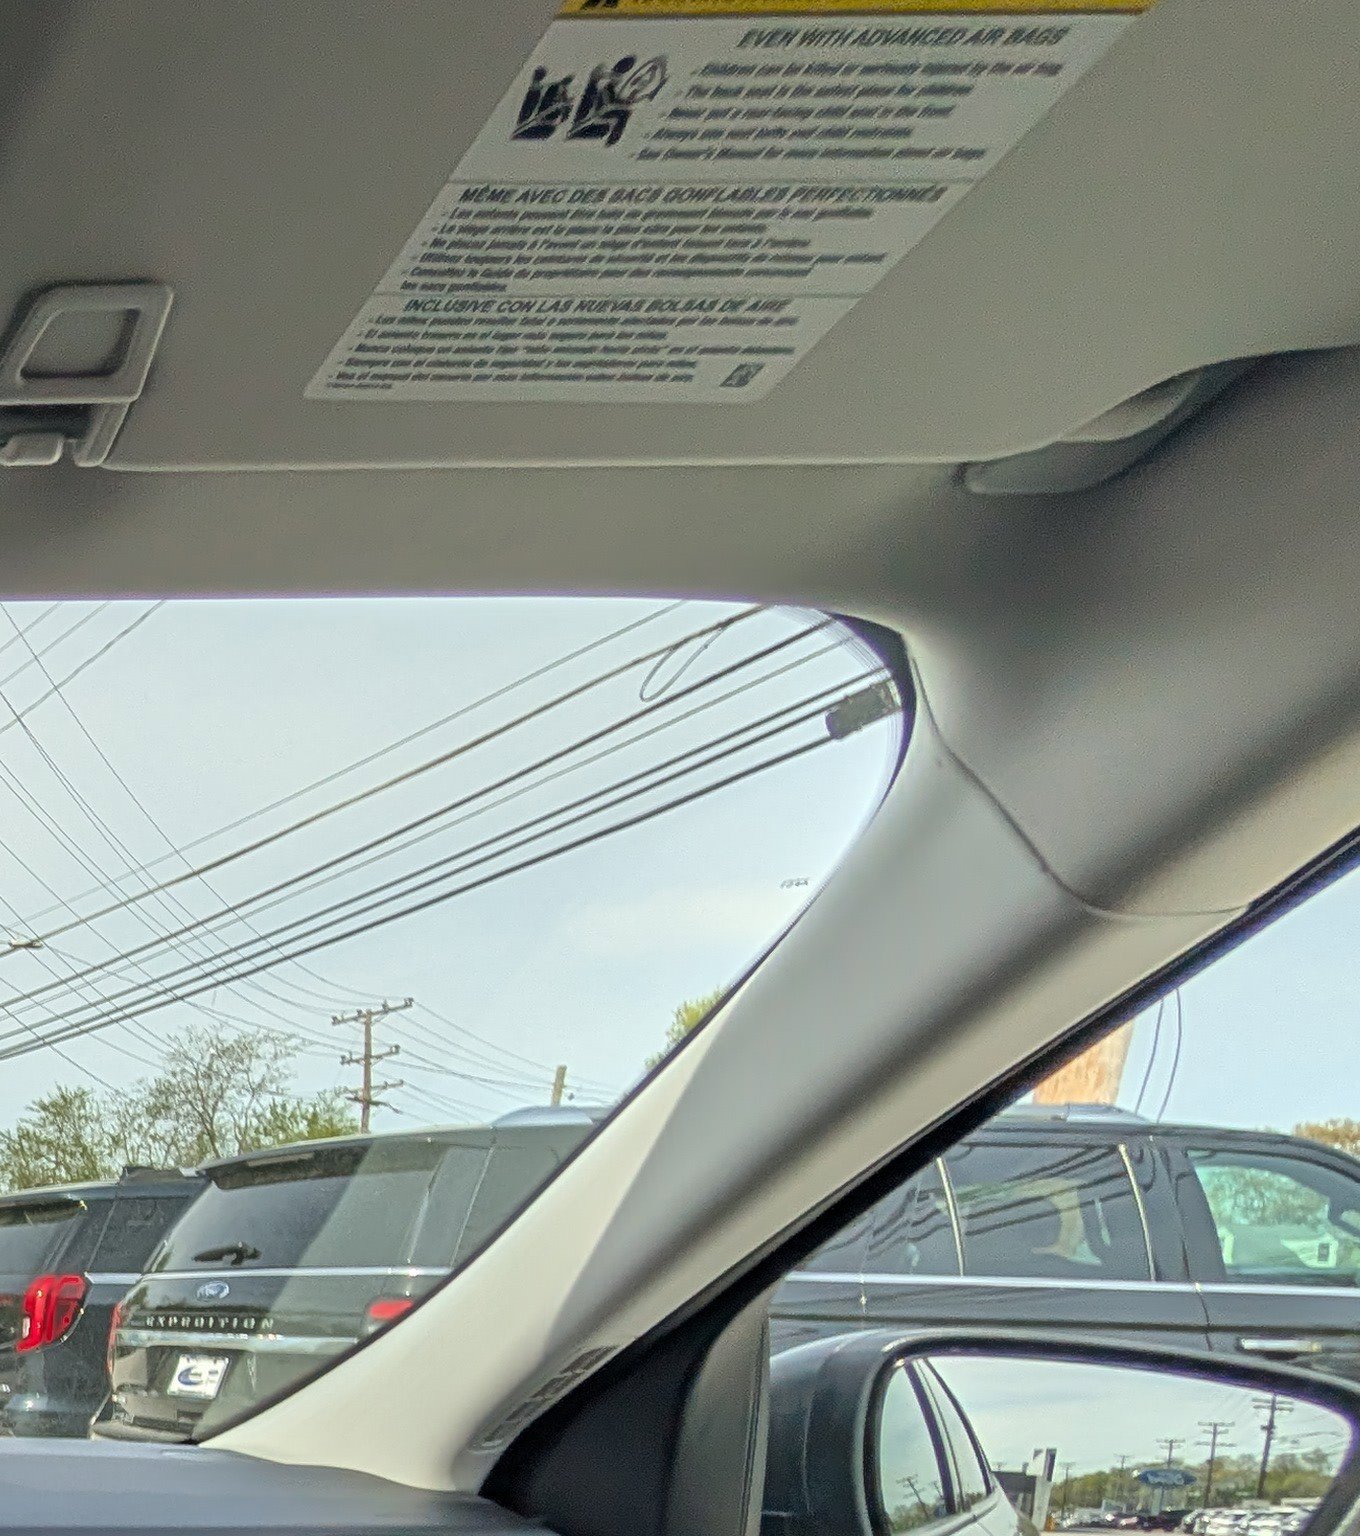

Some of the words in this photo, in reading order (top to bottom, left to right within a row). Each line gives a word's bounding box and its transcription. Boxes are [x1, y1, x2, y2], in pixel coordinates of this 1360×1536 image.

[735, 28, 802, 48] EVEN
[797, 28, 857, 47] WITH
[851, 28, 970, 47] ADVANCED
[963, 28, 1008, 46] AIR
